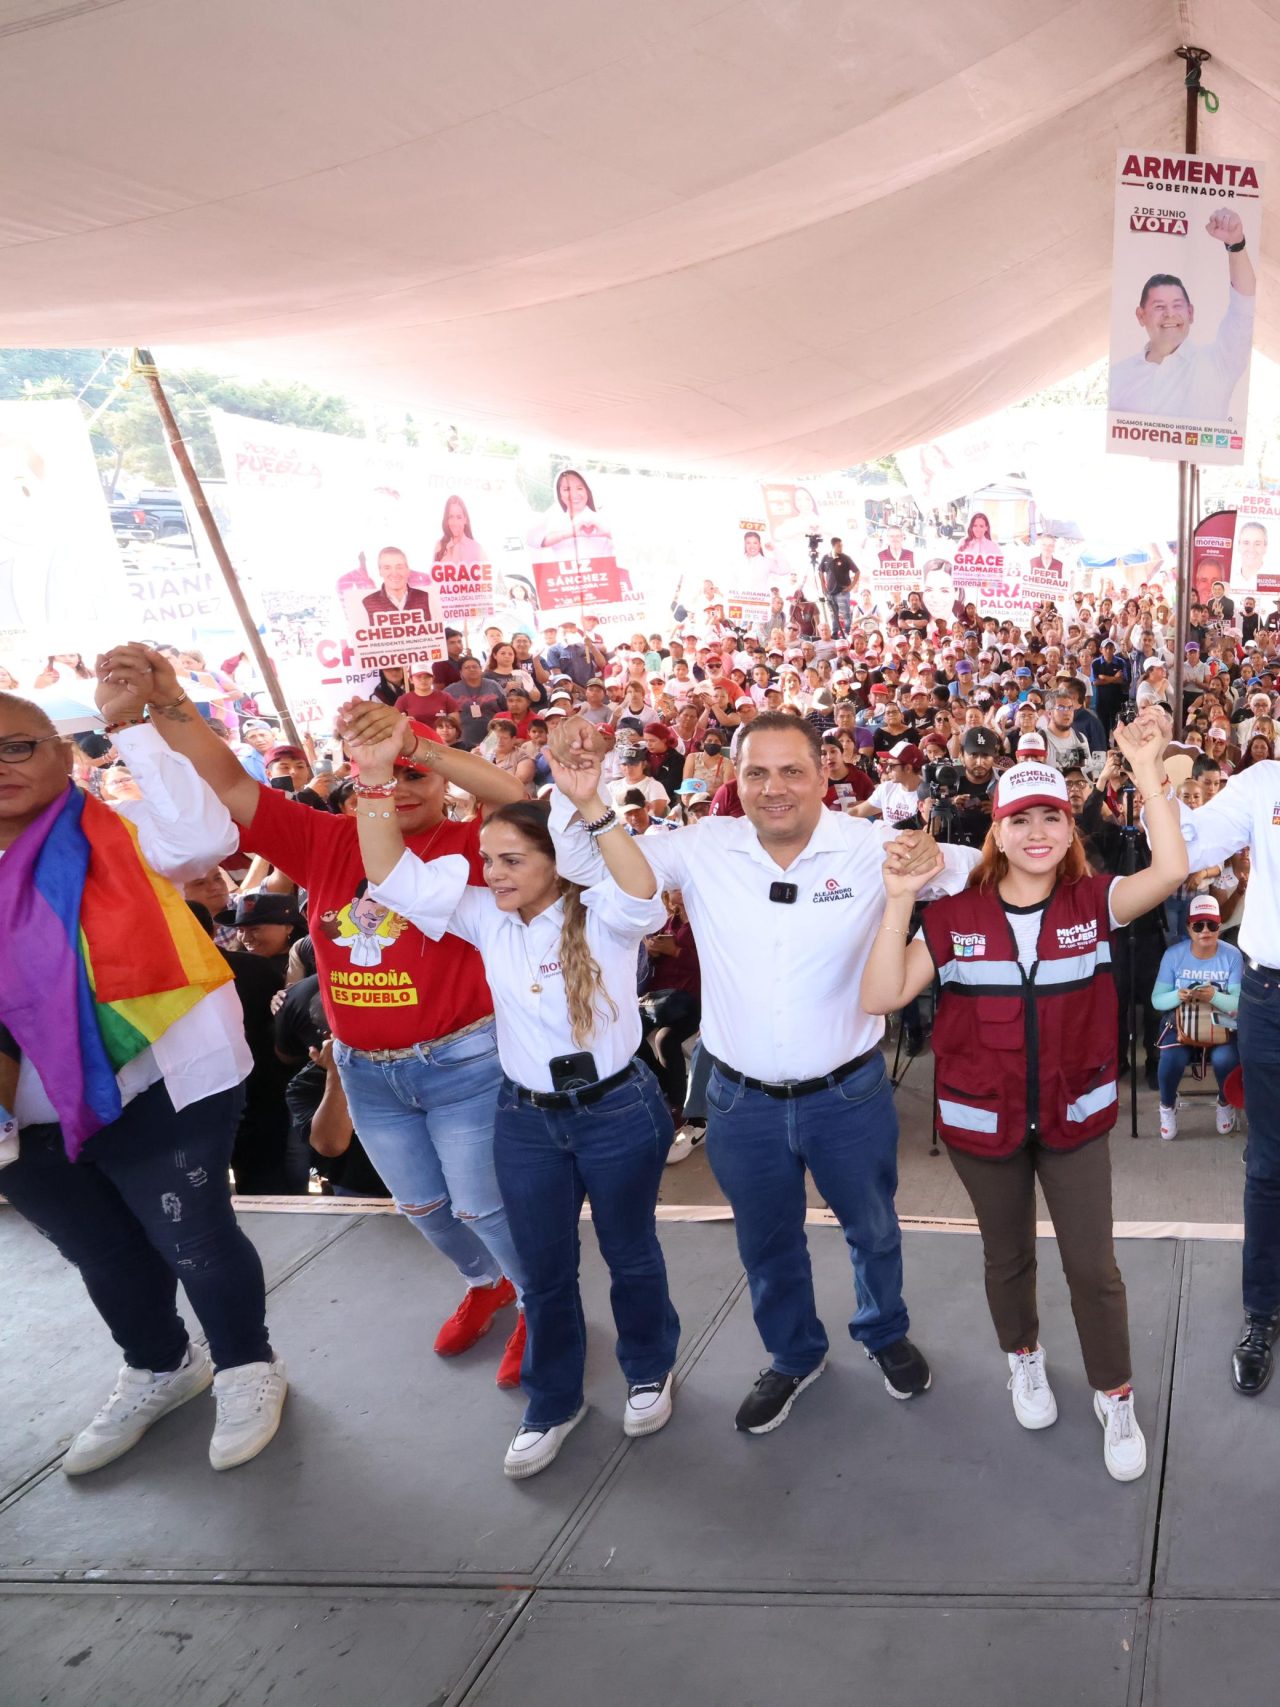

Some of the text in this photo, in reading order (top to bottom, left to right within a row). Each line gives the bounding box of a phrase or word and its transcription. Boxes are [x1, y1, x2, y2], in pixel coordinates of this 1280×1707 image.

[1122, 155, 1259, 189] ARMENTA
[1147, 182, 1235, 199] GOBERNADOR
[1133, 206, 1186, 219] 2 DE JUNIO
[1131, 216, 1187, 235] VOTA
[1116, 418, 1143, 427] SIGAMOS
[1144, 421, 1174, 429] HACIENDO
[1175, 423, 1202, 432] HISTORIA
[1213, 427, 1238, 435] PUEBLA
[1112, 425, 1182, 445] morena
[236, 452, 322, 478] PUEBLA
[1243, 496, 1271, 506] PEPE
[739, 521, 767, 531] VOTA
[1196, 538, 1225, 547] morena
[558, 558, 592, 575] LIZ
[885, 562, 909, 570] PEPE
[953, 554, 1004, 567] GRACE
[431, 563, 493, 583] GRACE
[872, 569, 922, 577] CHEDRAUI
[953, 565, 1003, 574] PALOMARES
[1034, 569, 1057, 579] PEPE
[874, 583, 912, 592] morena
[953, 579, 981, 588] morena
[1022, 575, 1069, 588] CHEDRAUI
[439, 583, 493, 595] ALOMARES
[1022, 590, 1056, 601] morena
[980, 600, 1041, 611] PALOMAR
[376, 611, 423, 627] PEPE
[444, 607, 470, 619] orena
[598, 611, 635, 626] orena
[355, 621, 443, 641] CHEDRAUI
[370, 637, 434, 649] PRESIDENTE MUNICIPAL
[361, 650, 429, 670] morena
[1009, 769, 1056, 782] MICHELLE
[1010, 777, 1057, 787] TALAVERA
[812, 892, 854, 904] CARVAJAL
[813, 887, 852, 898] ALEJANDRO
[330, 969, 413, 986] #NOROÑA
[335, 989, 411, 1003] ES PUEBLO
